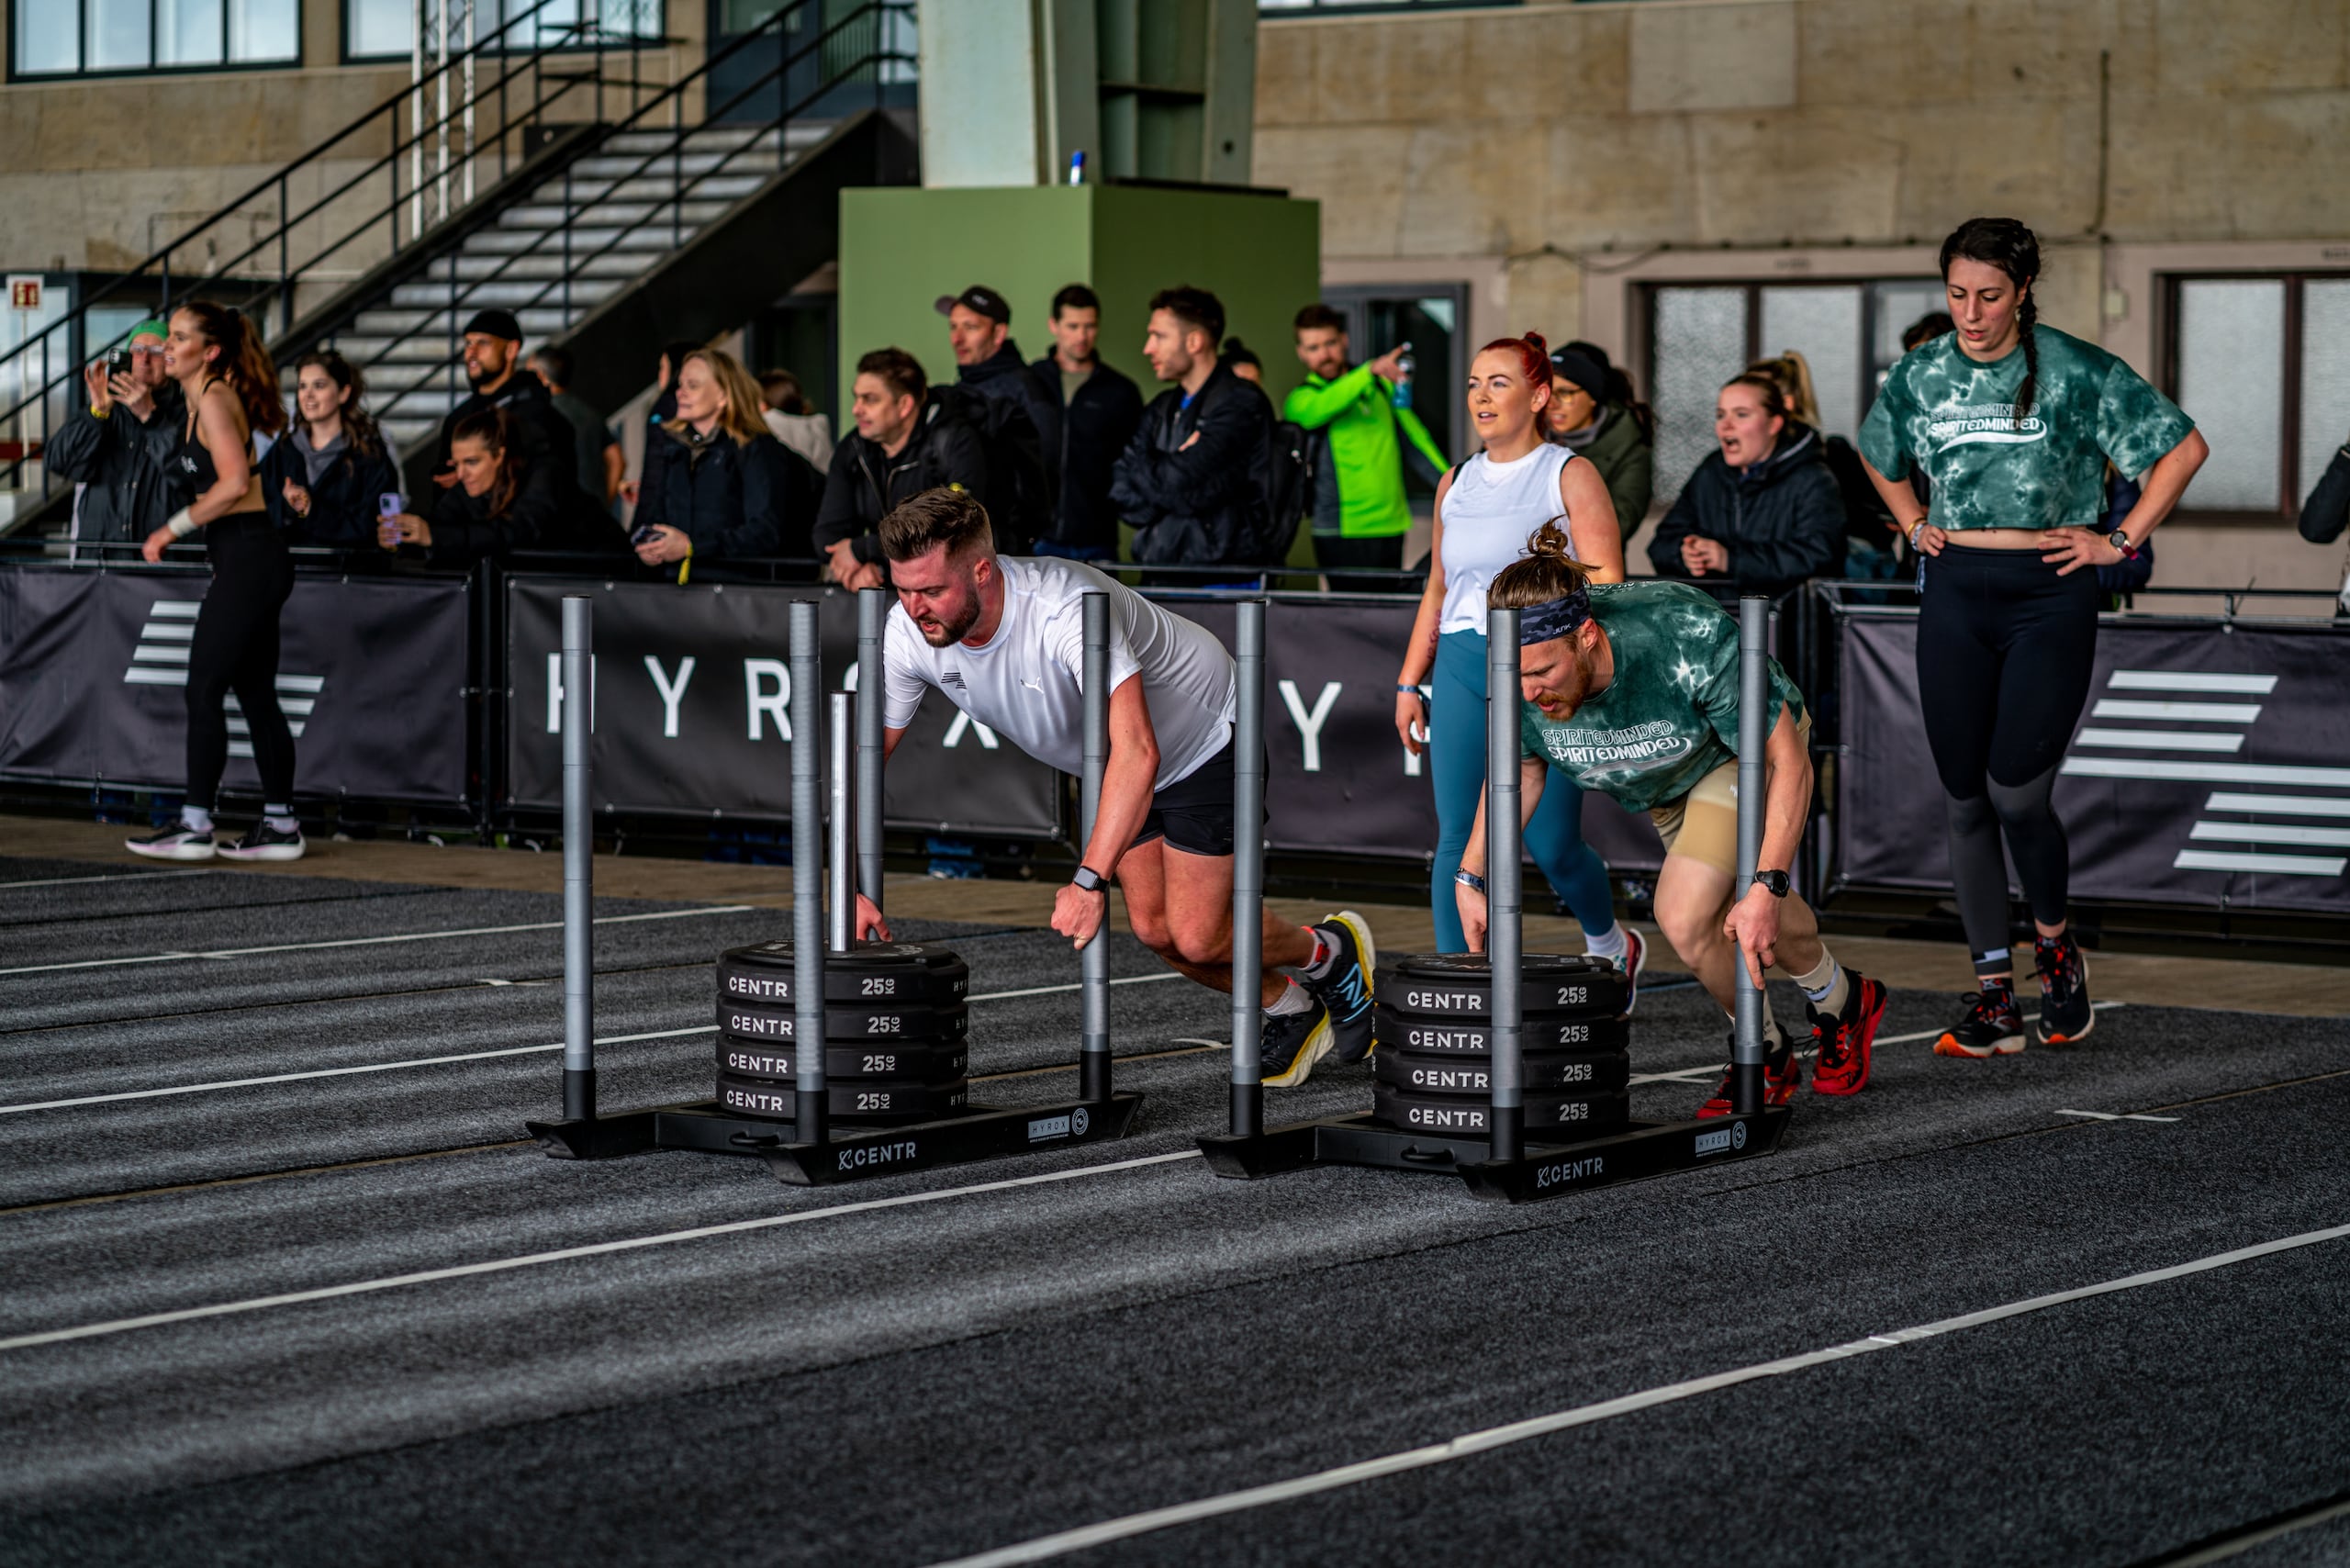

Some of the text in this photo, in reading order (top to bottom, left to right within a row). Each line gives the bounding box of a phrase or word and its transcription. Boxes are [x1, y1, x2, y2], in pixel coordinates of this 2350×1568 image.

[1548, 737, 1680, 763] SPIRITEDMINDED
[728, 976, 788, 998] CENTR
[1407, 991, 1483, 1011] CENTR
[731, 1014, 793, 1036] CENTR
[1408, 1029, 1484, 1049] CENTR
[728, 1052, 789, 1074] CENTR
[1412, 1069, 1489, 1088] CENTR
[726, 1090, 783, 1112] CENTR
[1408, 1107, 1484, 1127] CENTR
[854, 1141, 916, 1166] CENTR
[1550, 1157, 1603, 1183] CENTR
